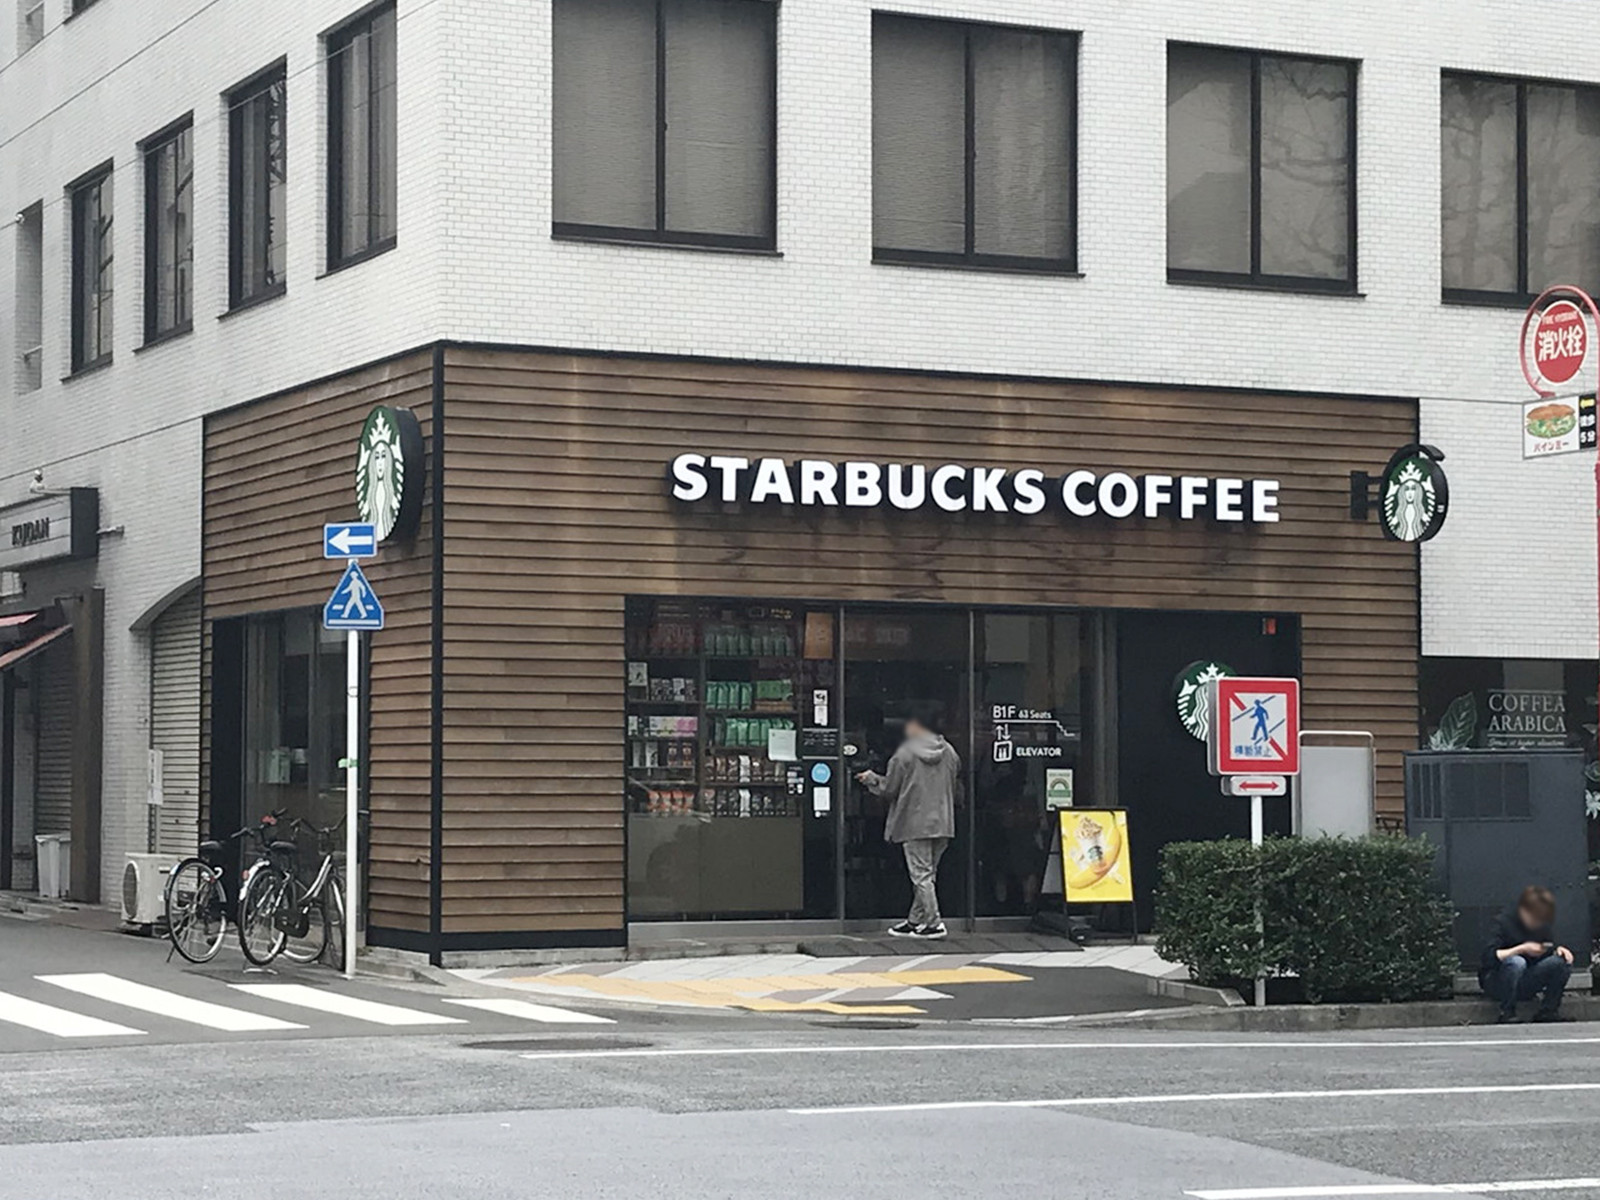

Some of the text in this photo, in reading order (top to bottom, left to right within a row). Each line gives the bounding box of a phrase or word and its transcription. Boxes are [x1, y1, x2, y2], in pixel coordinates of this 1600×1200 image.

[1538, 325, 1583, 361] 消火栓
[672, 453, 1280, 523] STARBUCKS COFFEE
[1488, 693, 1566, 712] COFFEA
[993, 705, 1017, 718] B1F
[1029, 709, 1052, 719] Seats
[1488, 715, 1567, 732] ARABICA
[1015, 746, 1062, 757] ELEVATOR
